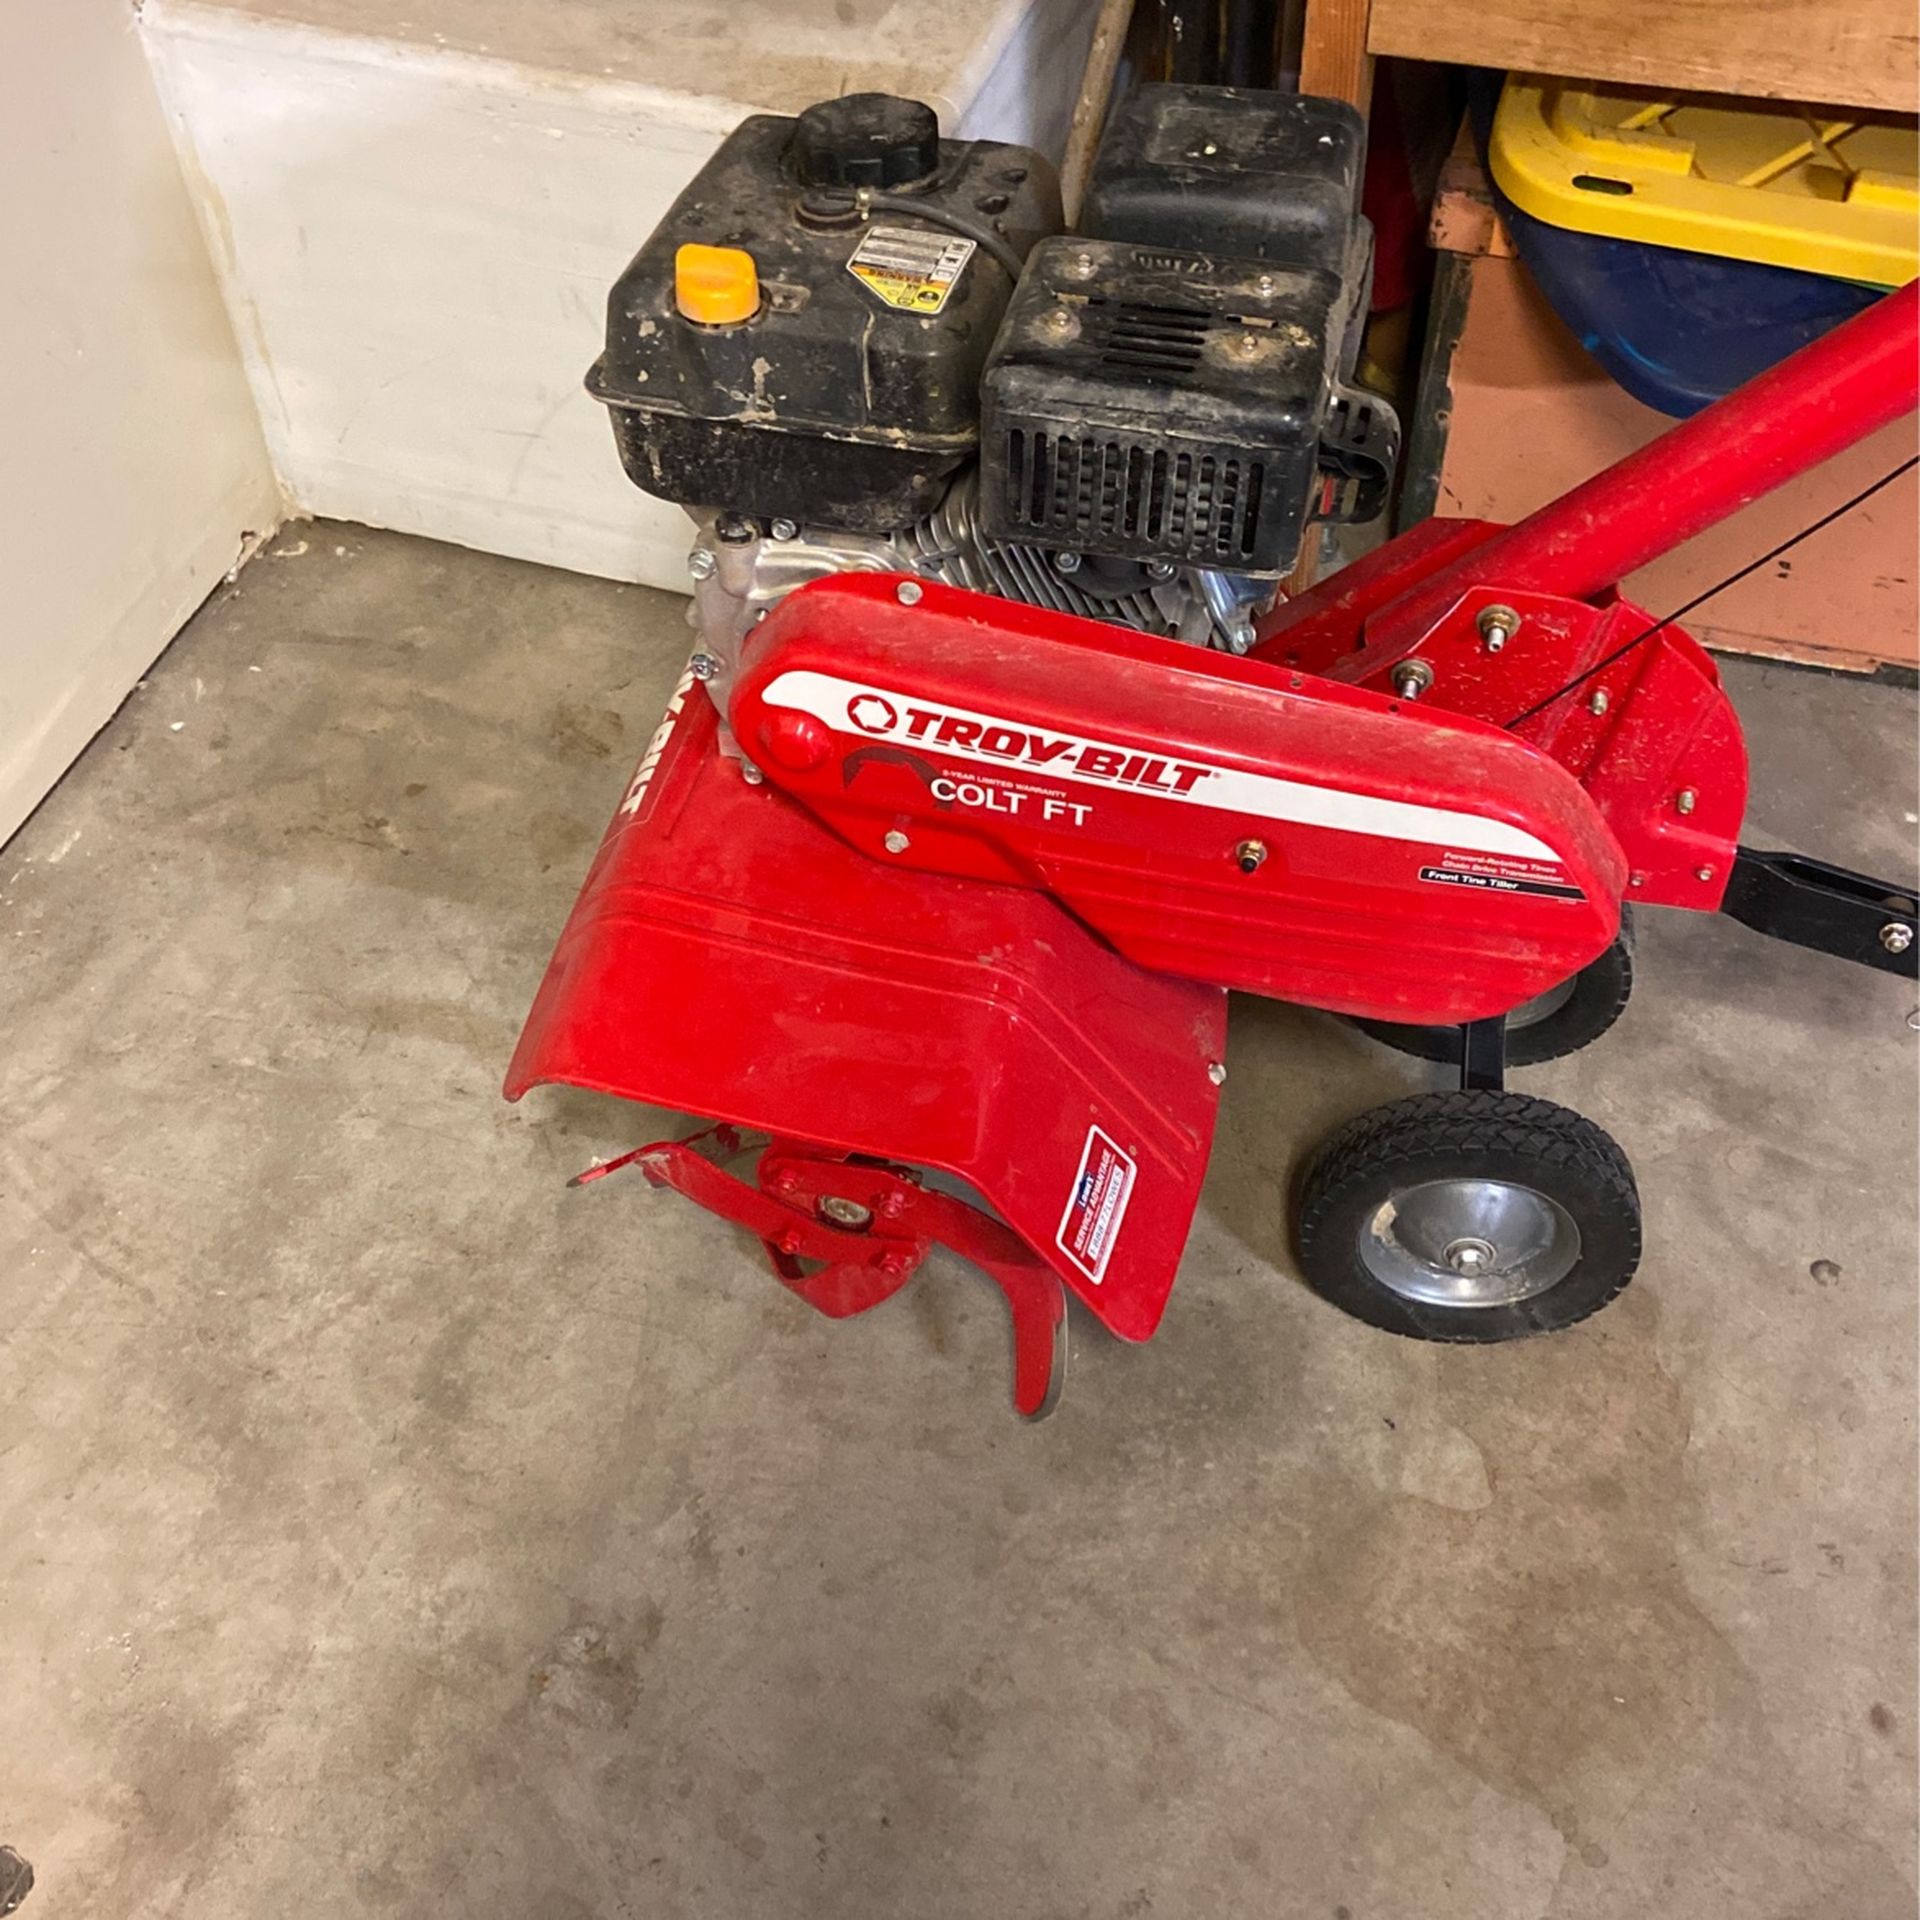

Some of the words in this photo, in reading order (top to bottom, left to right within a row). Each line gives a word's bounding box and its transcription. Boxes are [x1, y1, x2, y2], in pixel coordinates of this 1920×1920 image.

[905, 708, 1212, 795] TROY-BILT
[977, 776, 1014, 788] LIMITED
[1016, 783, 1067, 798] WARRANTY
[930, 778, 1028, 814] COLT
[1043, 801, 1093, 827] FT
[1443, 851, 1528, 870] Forward-Rotating
[1427, 870, 1459, 882] Front
[1461, 874, 1487, 886] Tine
[1490, 878, 1520, 890] Tiller
[1472, 864, 1498, 874] Drive
[1500, 868, 1565, 883] Transmission
[1074, 1206, 1093, 1251] SERVICE
[1089, 1148, 1111, 1209] ADVANTAGE
